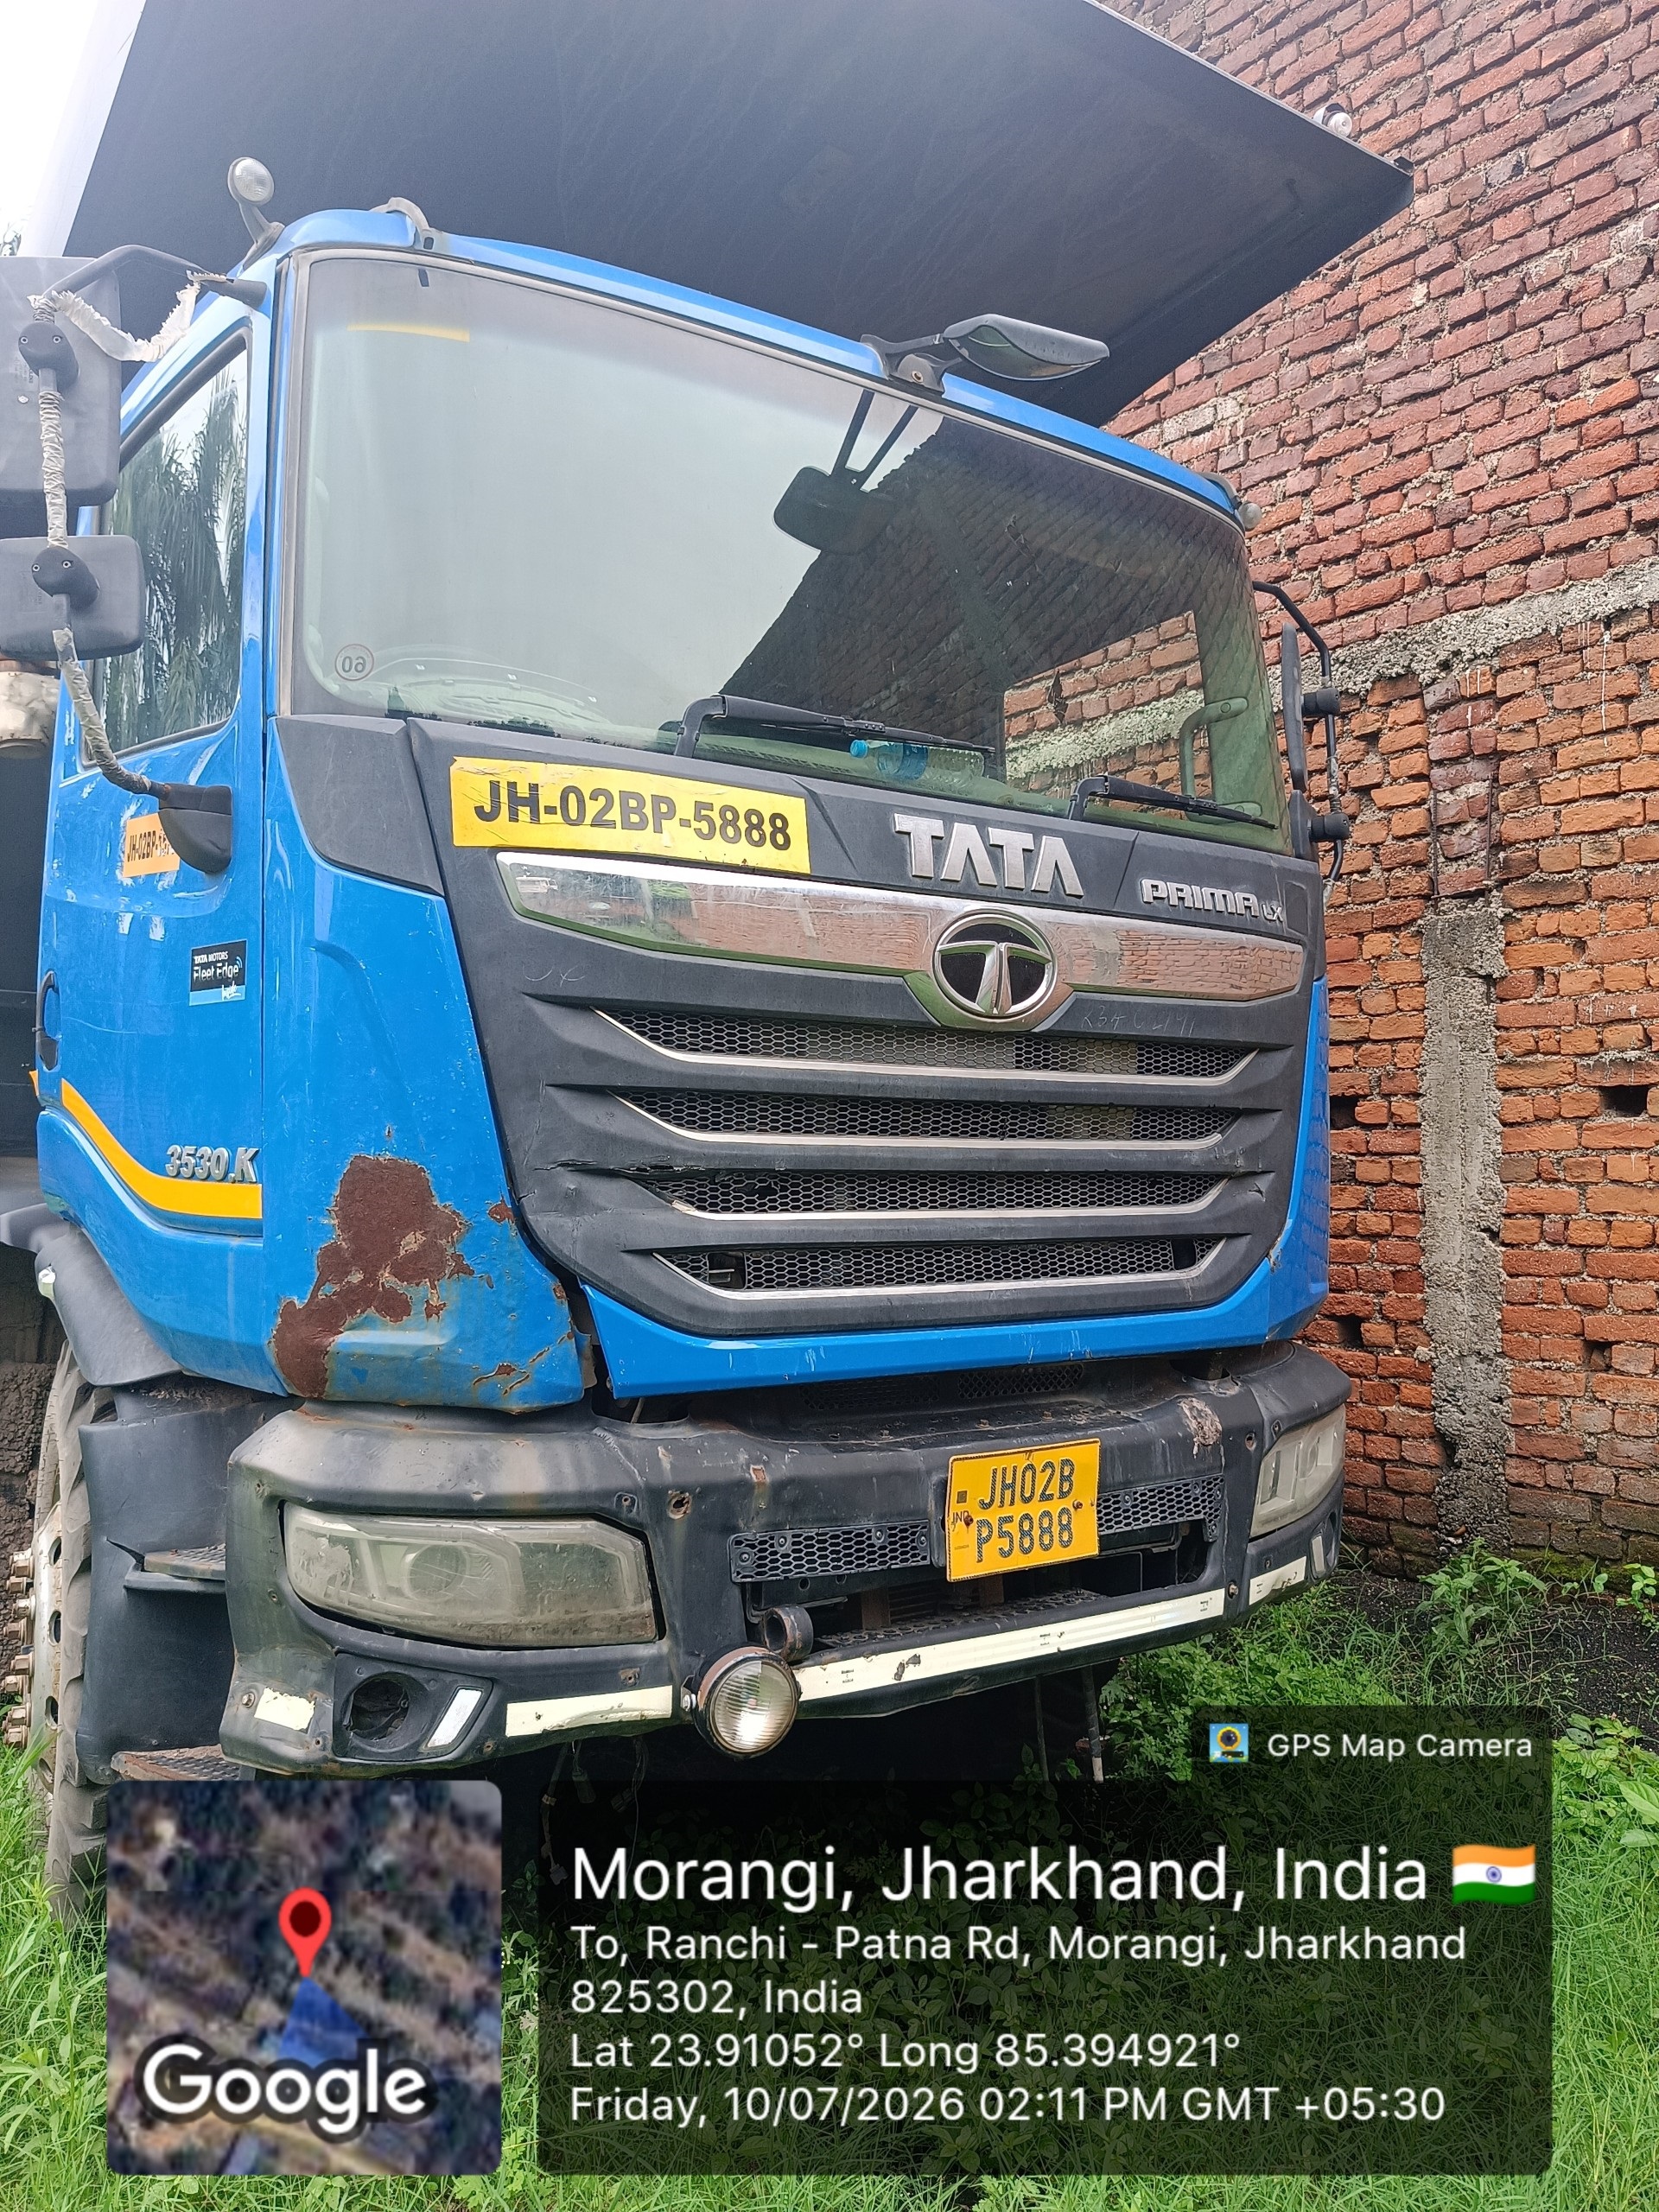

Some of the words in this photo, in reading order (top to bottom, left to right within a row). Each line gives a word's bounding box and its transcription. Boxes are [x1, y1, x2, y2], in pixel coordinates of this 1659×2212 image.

[474, 780, 791, 850] JH-02BP-5888
[893, 813, 1084, 899] TATA
[1141, 878, 1260, 918] PRIMA
[1262, 902, 1284, 922] LX
[194, 954, 207, 964] TATA
[208, 950, 229, 962] MOTORS
[194, 965, 215, 982] Fleet
[216, 962, 239, 982] Edge
[978, 1458, 1075, 1510] JH02B
[976, 1506, 1074, 1563] P5888
